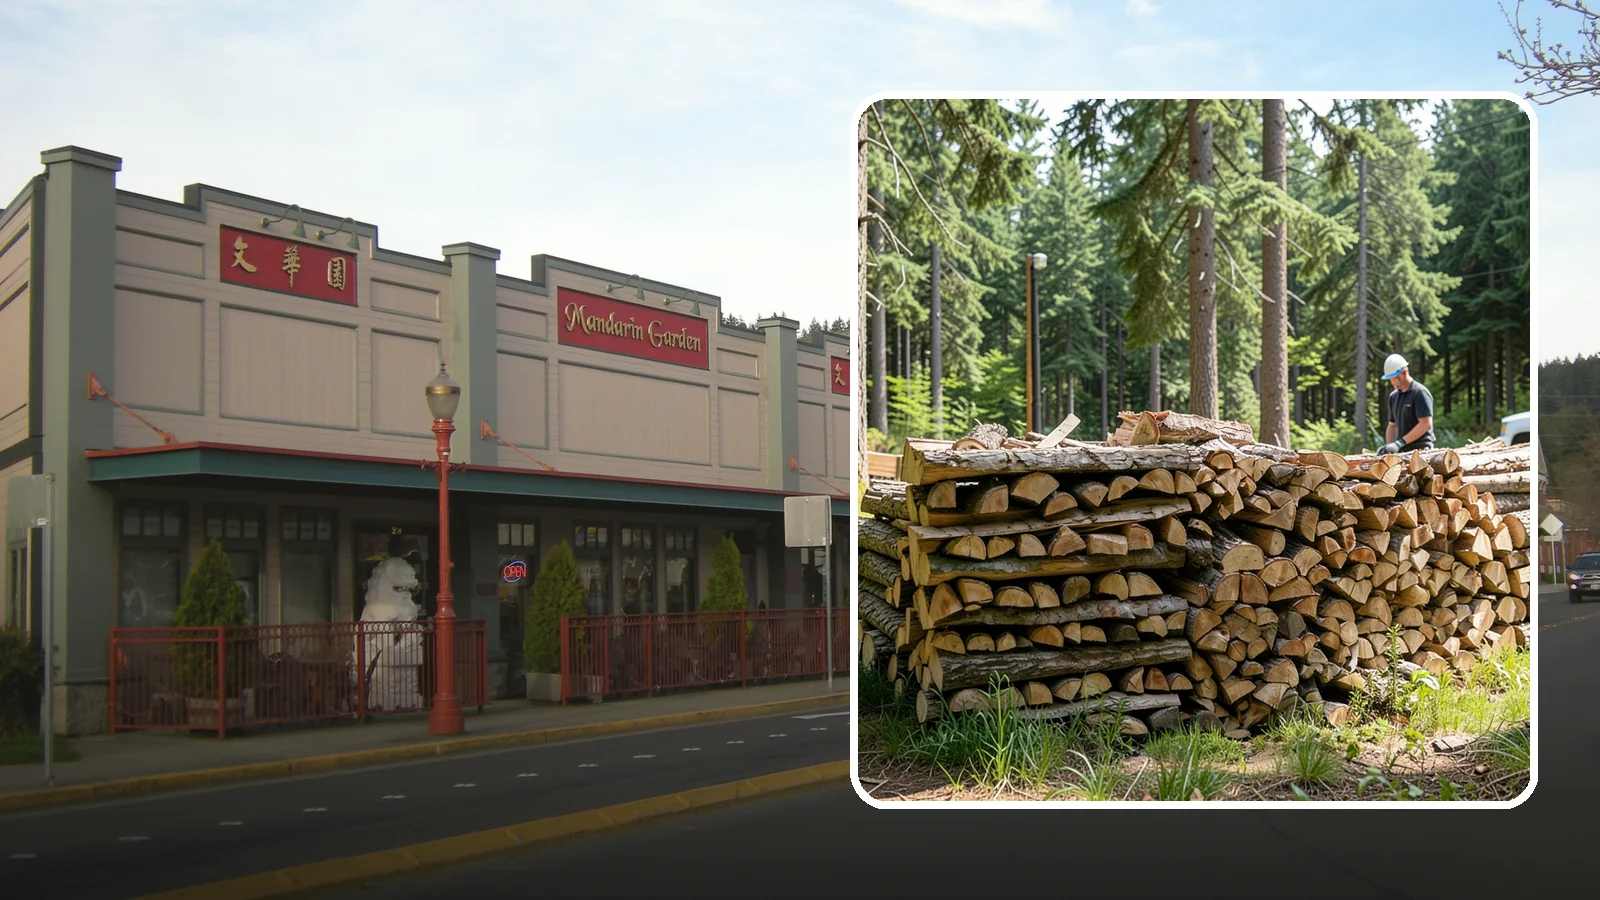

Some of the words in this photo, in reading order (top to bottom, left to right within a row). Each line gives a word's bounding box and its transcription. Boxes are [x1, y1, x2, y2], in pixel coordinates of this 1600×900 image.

[230, 235, 346, 291] 文華園
[564, 302, 643, 341] Mandarin
[648, 320, 702, 352] Garden
[834, 362, 847, 387] 文
[503, 565, 527, 578] OPEN
